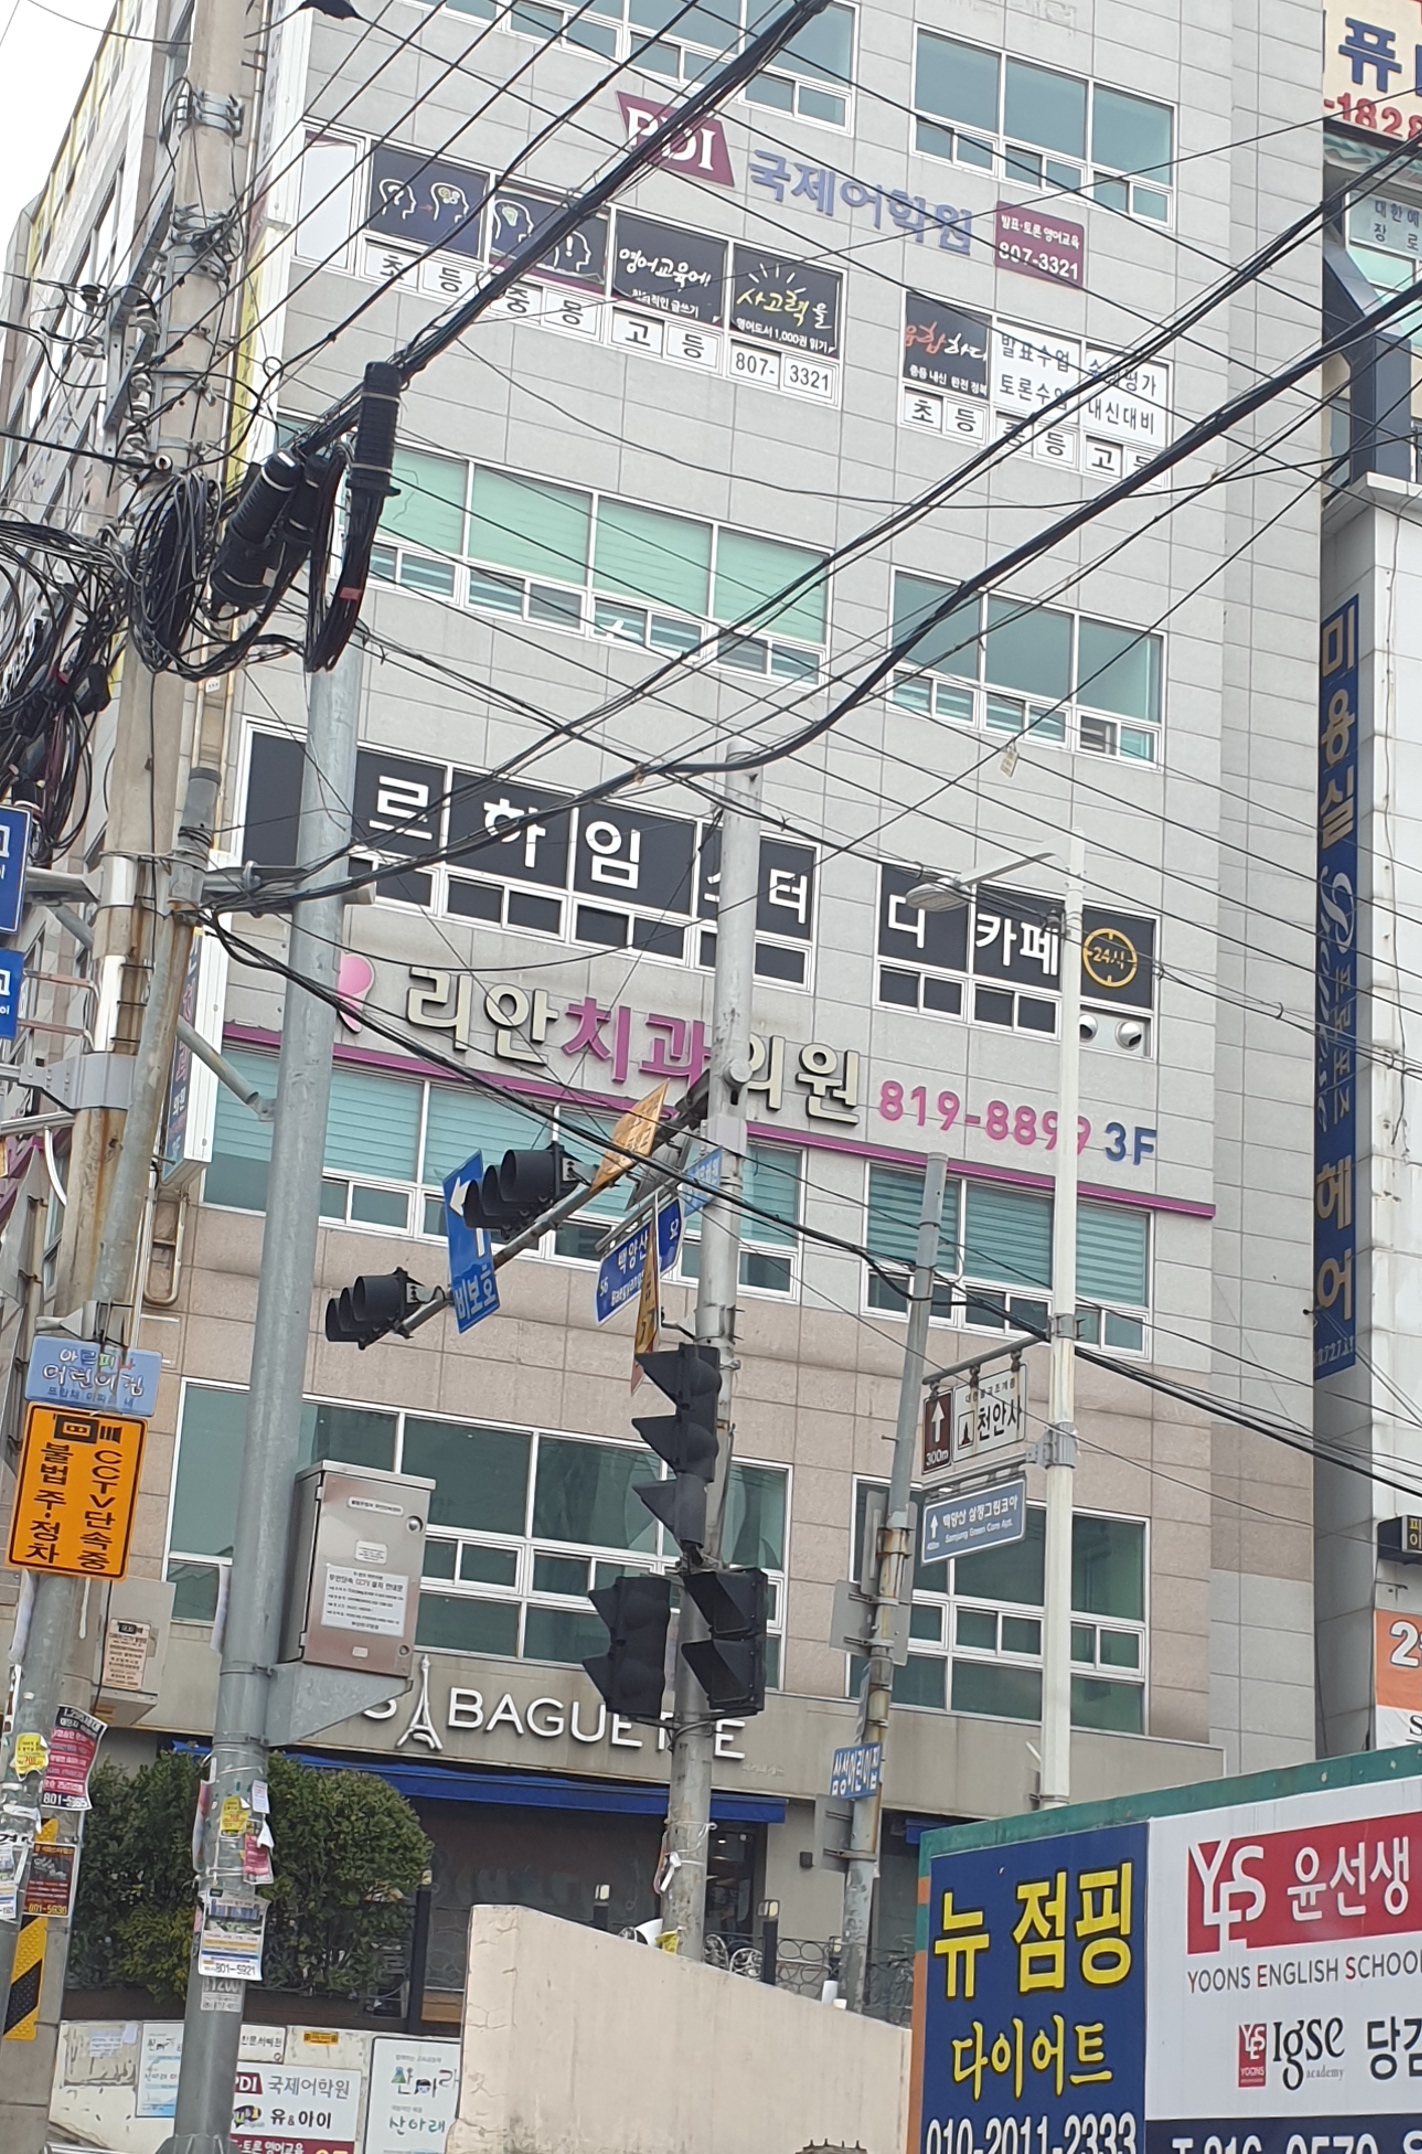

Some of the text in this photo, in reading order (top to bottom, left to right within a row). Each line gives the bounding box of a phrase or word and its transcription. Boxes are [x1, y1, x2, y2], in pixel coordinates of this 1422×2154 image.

[1338, 17, 1422, 97] 퓨
[749, 149, 973, 256] 국제어학원
[999, 242, 1078, 280] 807-3321
[1043, 227, 1080, 250] 영어교육
[736, 318, 828, 354] 영어도서 1,000권 읽기
[1000, 333, 1071, 374] 발표수업
[1088, 398, 1154, 436] 내신대비
[1320, 604, 1355, 849] 미용실
[1104, 1121, 1158, 1166] 3F
[618, 1230, 648, 1275] 백양산
[1316, 1155, 1352, 1321] 헤어
[455, 1263, 496, 1320] 비보호
[43, 1364, 144, 1397] 어린이집
[977, 1394, 1022, 1442] 천안사
[925, 1448, 949, 1467] 300m
[1287, 1836, 1409, 1922] 윤선생
[934, 1860, 1133, 1998] 뉴 점핑
[1187, 1950, 1422, 1994] YOONS ENGLISH SCHOO
[952, 2013, 1114, 2100] 다이어트
[268, 2075, 351, 2100] 국제어학원
[389, 2115, 446, 2136] 산아래
